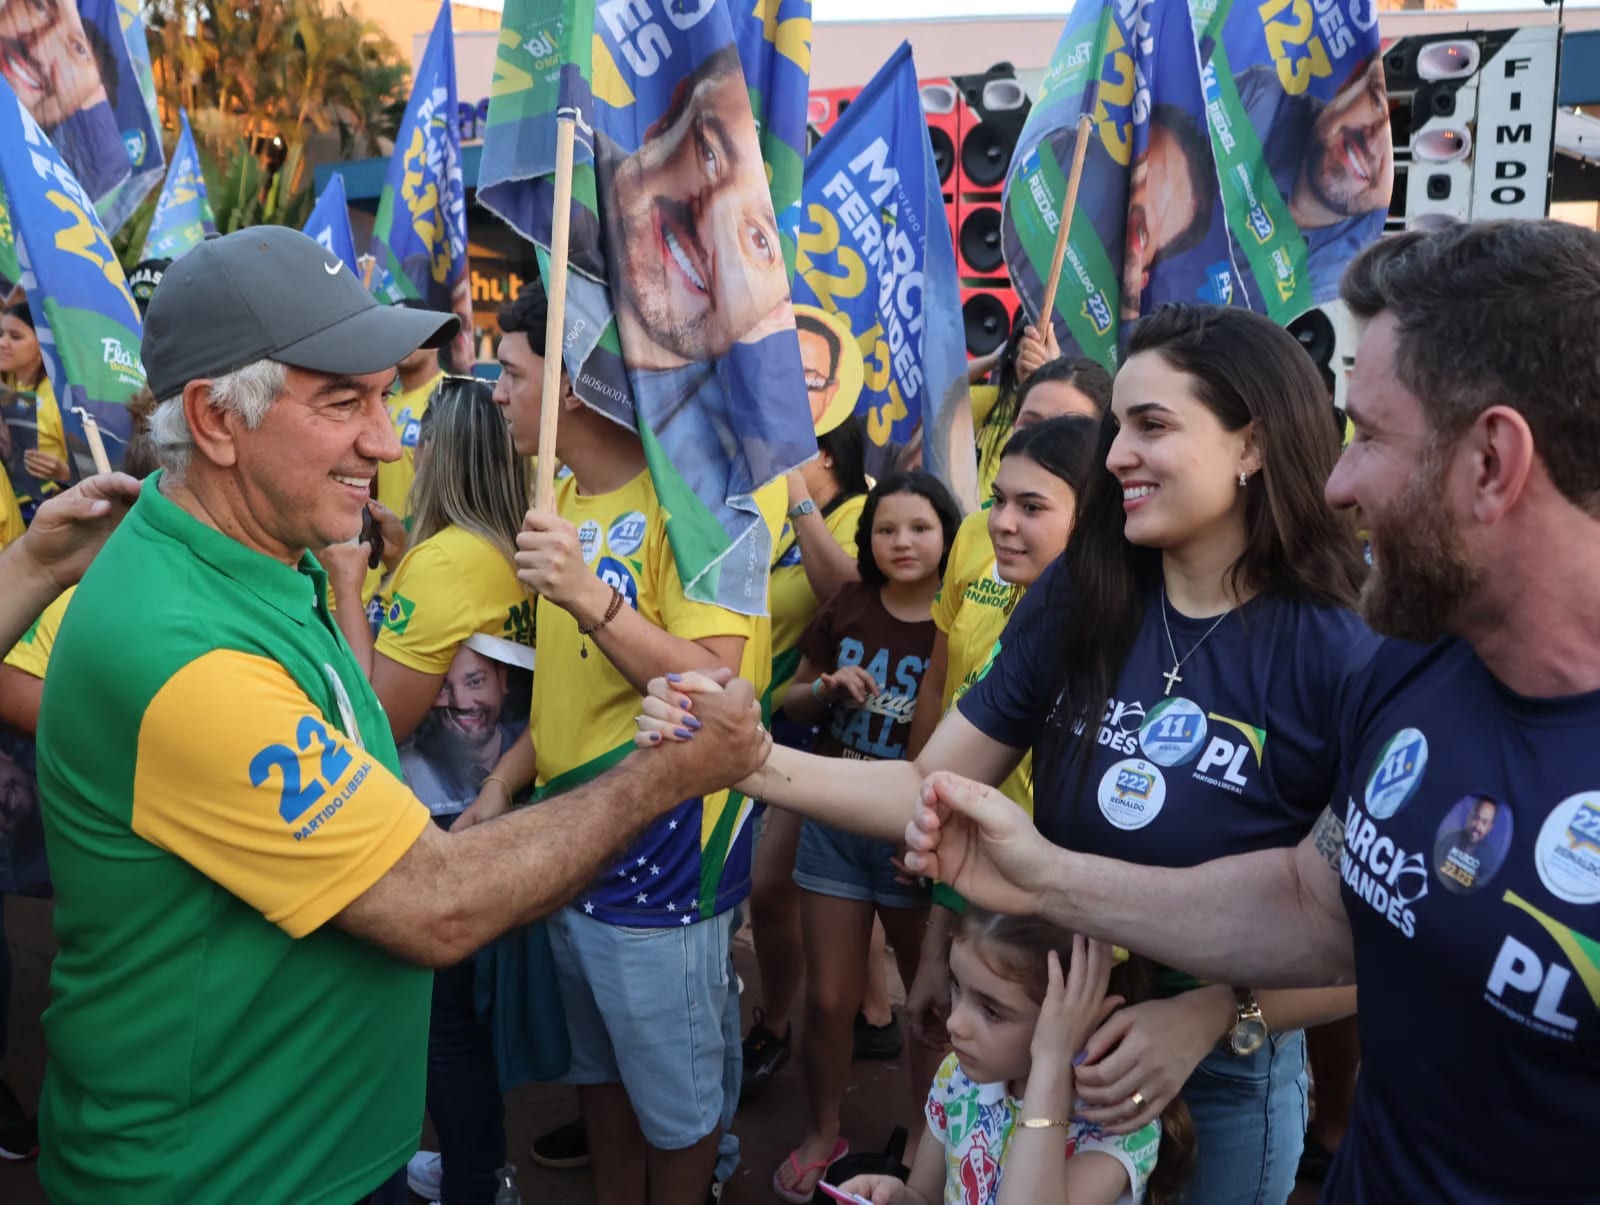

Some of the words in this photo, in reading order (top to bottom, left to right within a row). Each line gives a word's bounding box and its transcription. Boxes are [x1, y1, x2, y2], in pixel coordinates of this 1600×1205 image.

[1029, 173, 1060, 234] RIEDEL
[1251, 208, 1271, 238] 222
[471, 271, 523, 301] hut
[1219, 271, 1232, 300] PL
[1088, 293, 1110, 328] 222
[1158, 715, 1187, 738] 11
[249, 715, 353, 824] 22
[1196, 736, 1250, 787] PL
[1118, 771, 1149, 793] 222
[293, 797, 343, 841] PARTIDO
[1110, 795, 1145, 812] REINALDO
[1486, 935, 1578, 1031] PL
